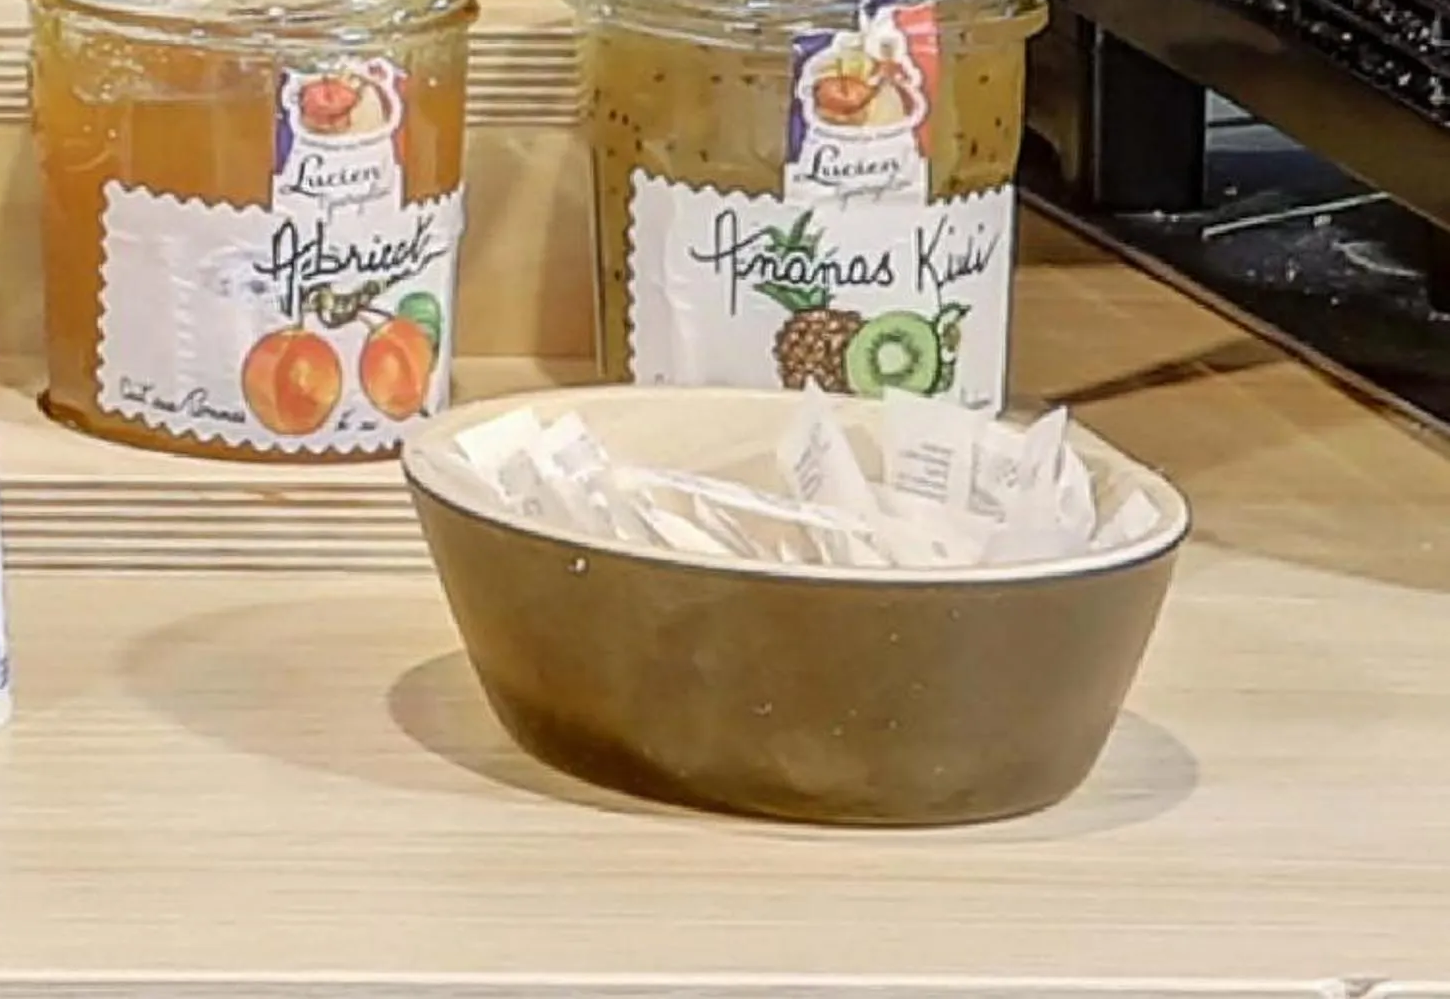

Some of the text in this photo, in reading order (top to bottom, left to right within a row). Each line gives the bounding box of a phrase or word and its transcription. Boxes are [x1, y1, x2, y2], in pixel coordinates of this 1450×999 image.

[279, 154, 381, 197] Lucien
[793, 144, 900, 187] Lucien
[253, 213, 448, 317] Abricot
[690, 208, 894, 317] Ananas
